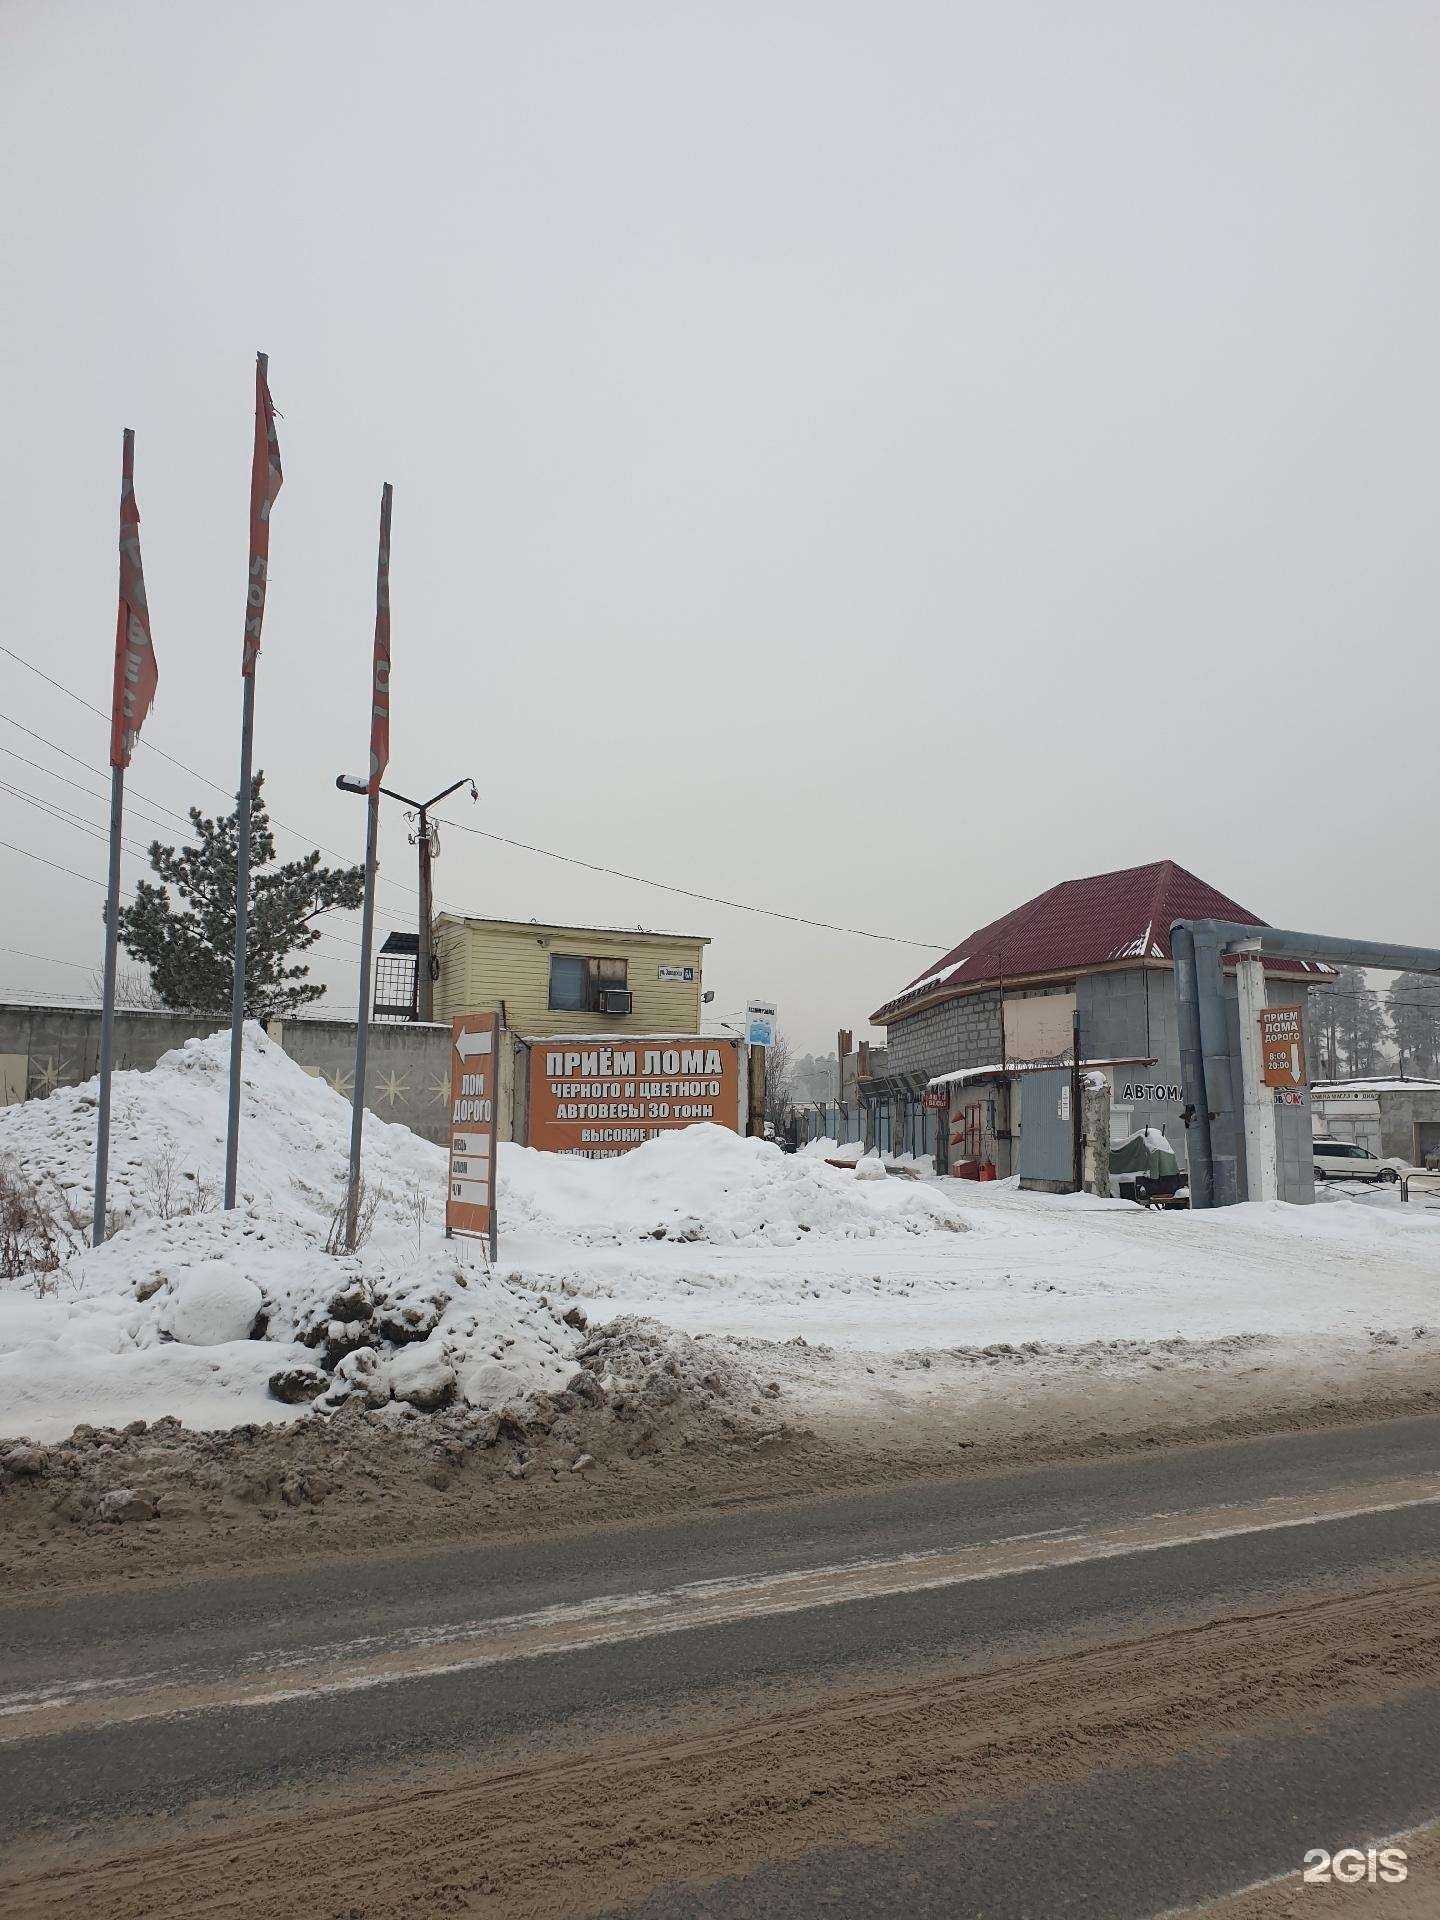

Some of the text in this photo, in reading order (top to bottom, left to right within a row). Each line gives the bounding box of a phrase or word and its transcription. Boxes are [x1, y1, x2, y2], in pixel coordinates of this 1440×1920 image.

[1263, 1011, 1298, 1022] ПРИЕМ
[1265, 1021, 1299, 1033] ЛОМА
[1265, 1032, 1300, 1043] ДОРОГО
[546, 1047, 723, 1076] ПРИЁМ ЛОМА
[462, 1073, 485, 1096] ЛОМ
[551, 1080, 721, 1099] ЧЕРНОГО И ЦВЕТНОГО
[453, 1099, 491, 1124] ДОРОГО
[556, 1103, 645, 1119] АВТОВЕСЫ
[648, 1102, 670, 1118] 30
[581, 1128, 648, 1142] ВЫСОКИЕ
